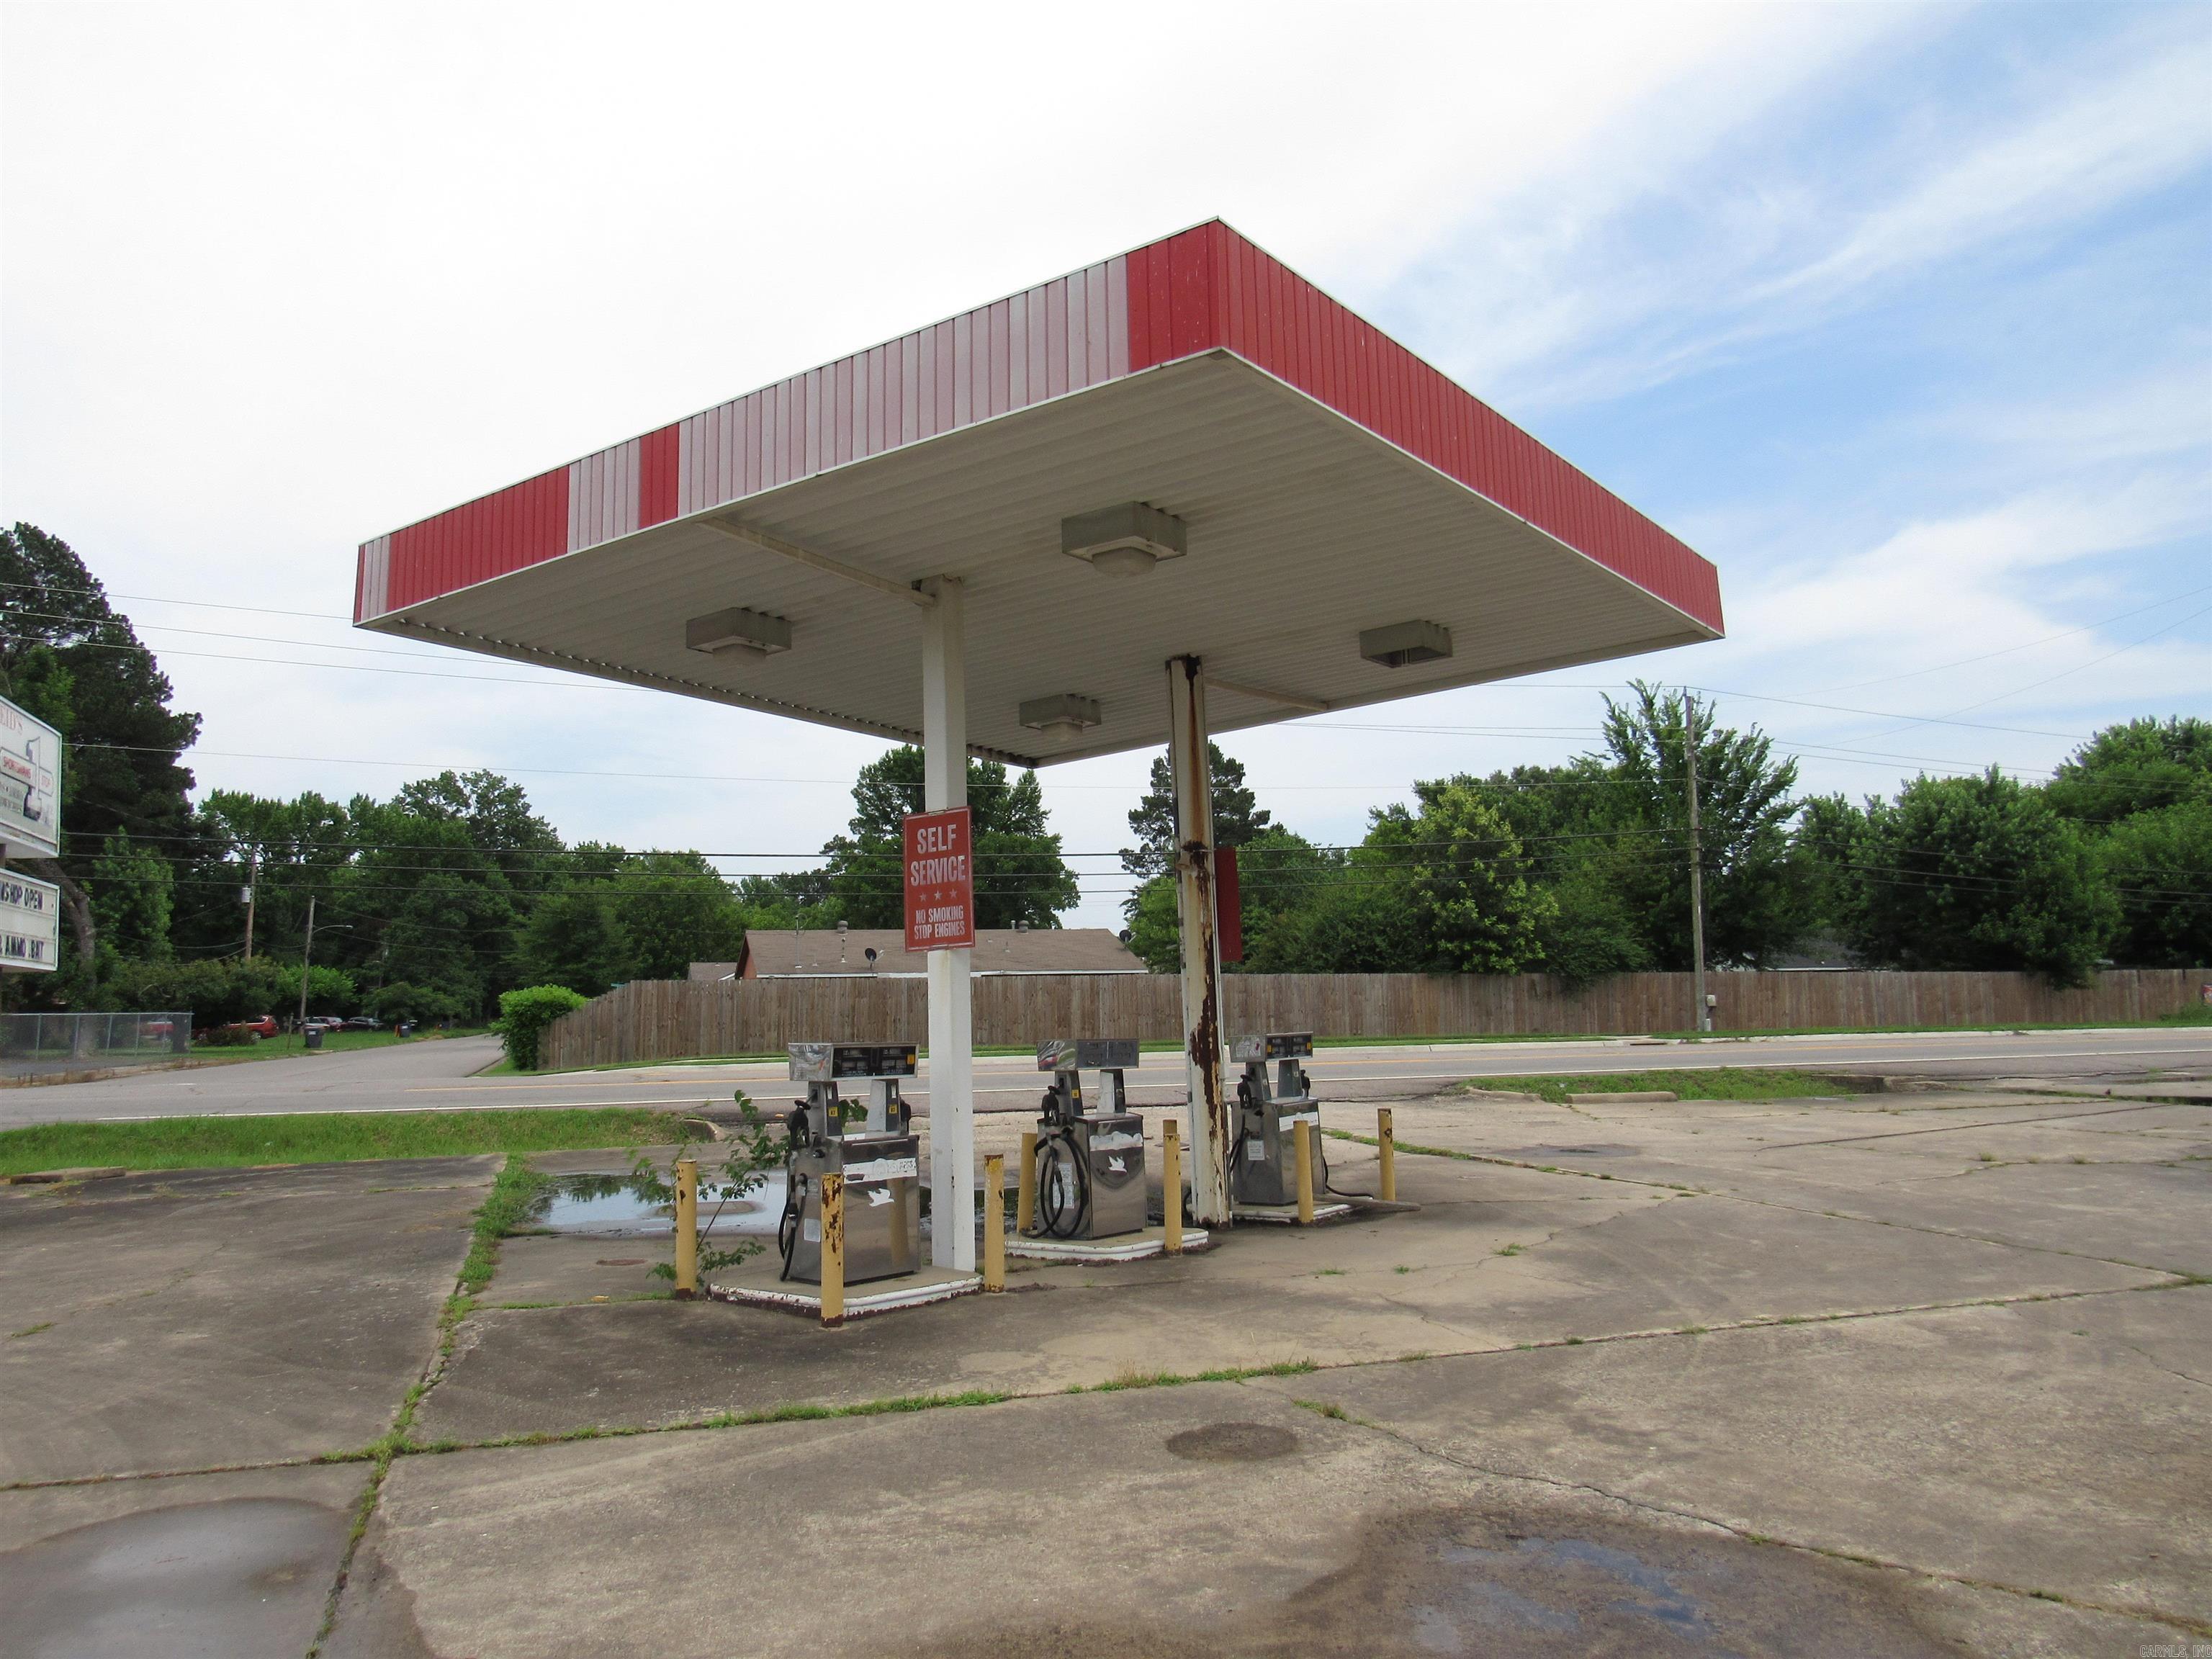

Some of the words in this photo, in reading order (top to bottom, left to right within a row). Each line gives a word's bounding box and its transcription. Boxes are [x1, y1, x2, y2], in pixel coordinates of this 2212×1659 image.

[917, 824, 957, 854] SELF
[910, 855, 966, 886] SERVICE
[24, 887, 43, 910] OPEN
[915, 909, 926, 925] NO
[928, 905, 964, 922] SMOKING
[914, 925, 932, 940] STOP
[935, 921, 965, 938] ENGINES
